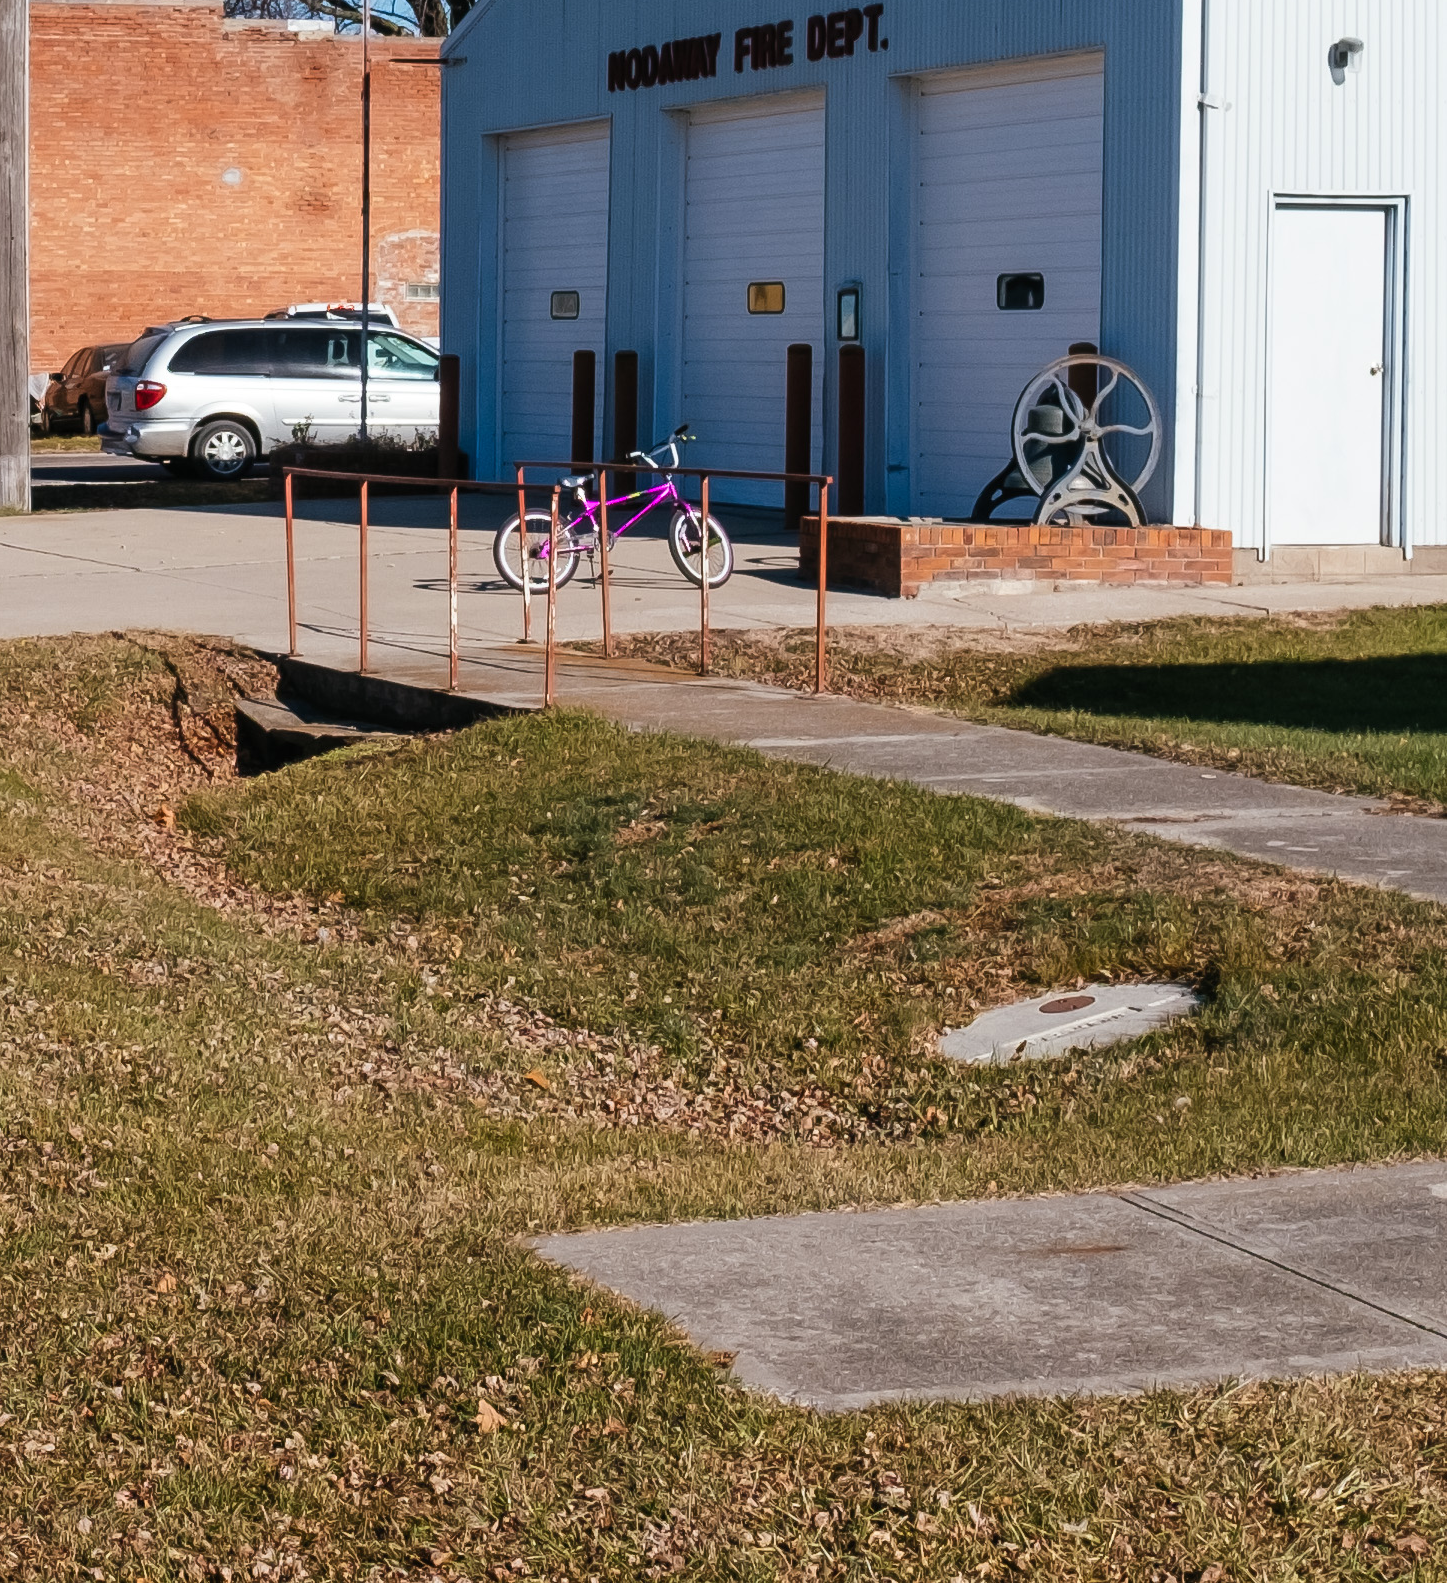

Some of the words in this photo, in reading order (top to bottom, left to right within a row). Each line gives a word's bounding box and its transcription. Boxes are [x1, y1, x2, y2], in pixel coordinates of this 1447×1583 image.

[608, 32, 722, 92] NODAWAY
[734, 19, 794, 74] FIRE
[807, 2, 889, 62] DEPT.
